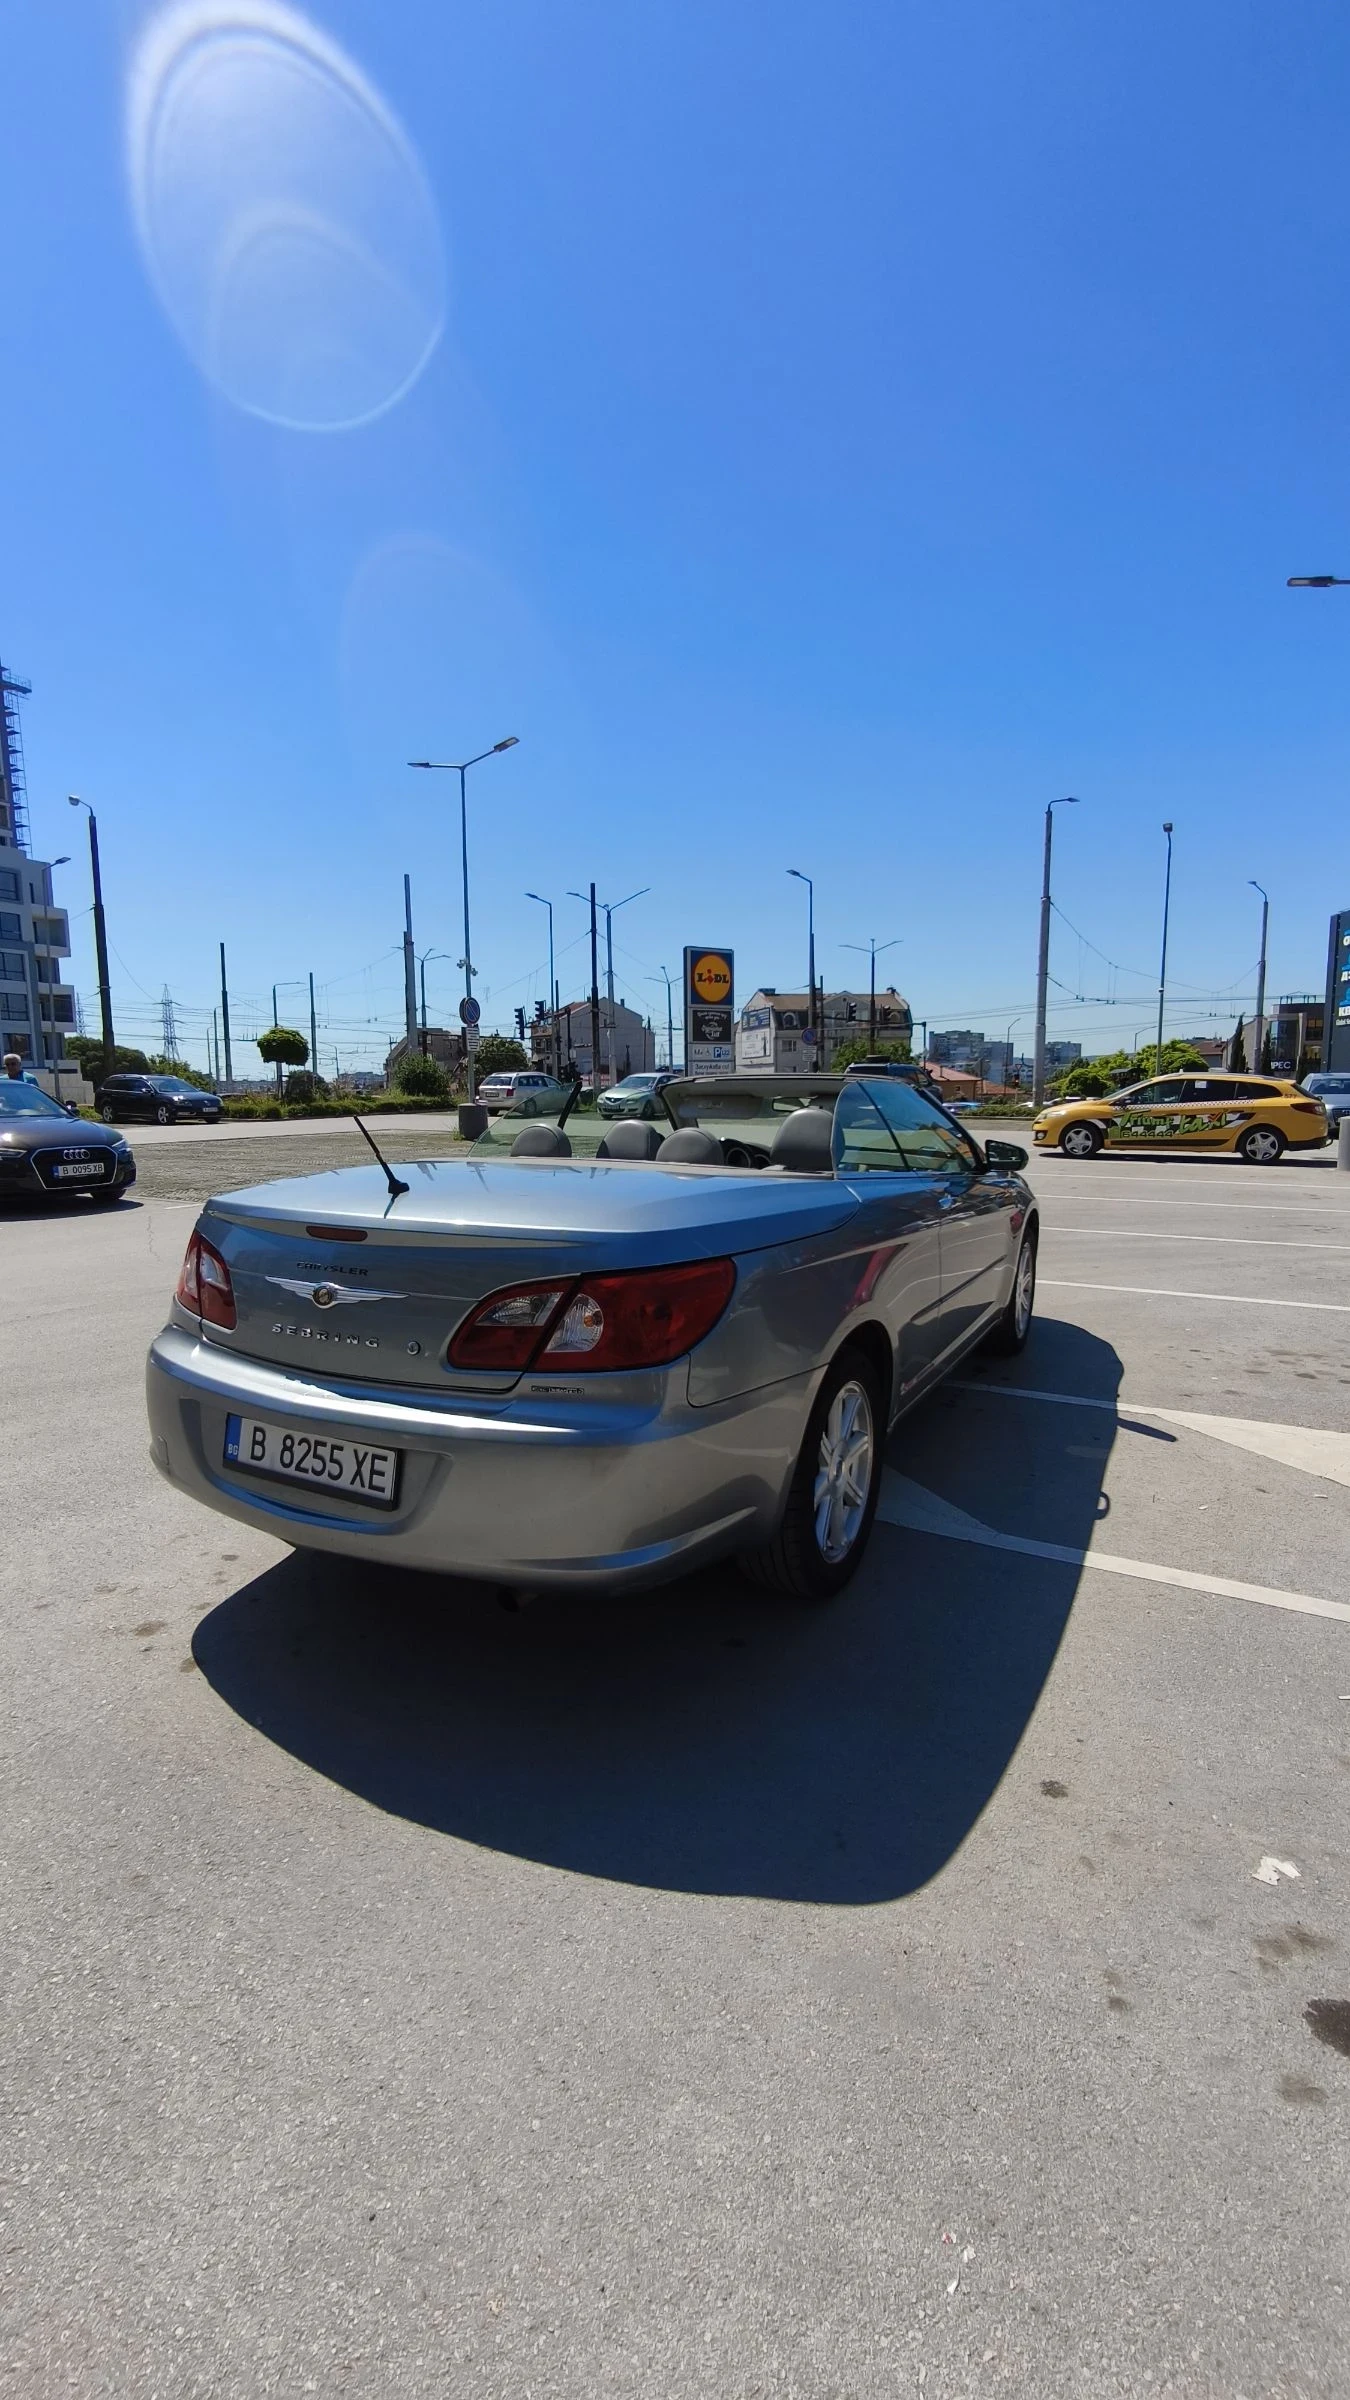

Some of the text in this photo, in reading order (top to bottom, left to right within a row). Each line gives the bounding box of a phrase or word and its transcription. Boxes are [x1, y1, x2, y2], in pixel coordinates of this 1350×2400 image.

[1121, 1129, 1174, 1138] 644444
[62, 1164, 103, 1175] B 0095 XB
[296, 1261, 370, 1277] CHRYSLER
[271, 1322, 381, 1348] SEBRING
[227, 1426, 389, 1494] BG B 8255 XE
